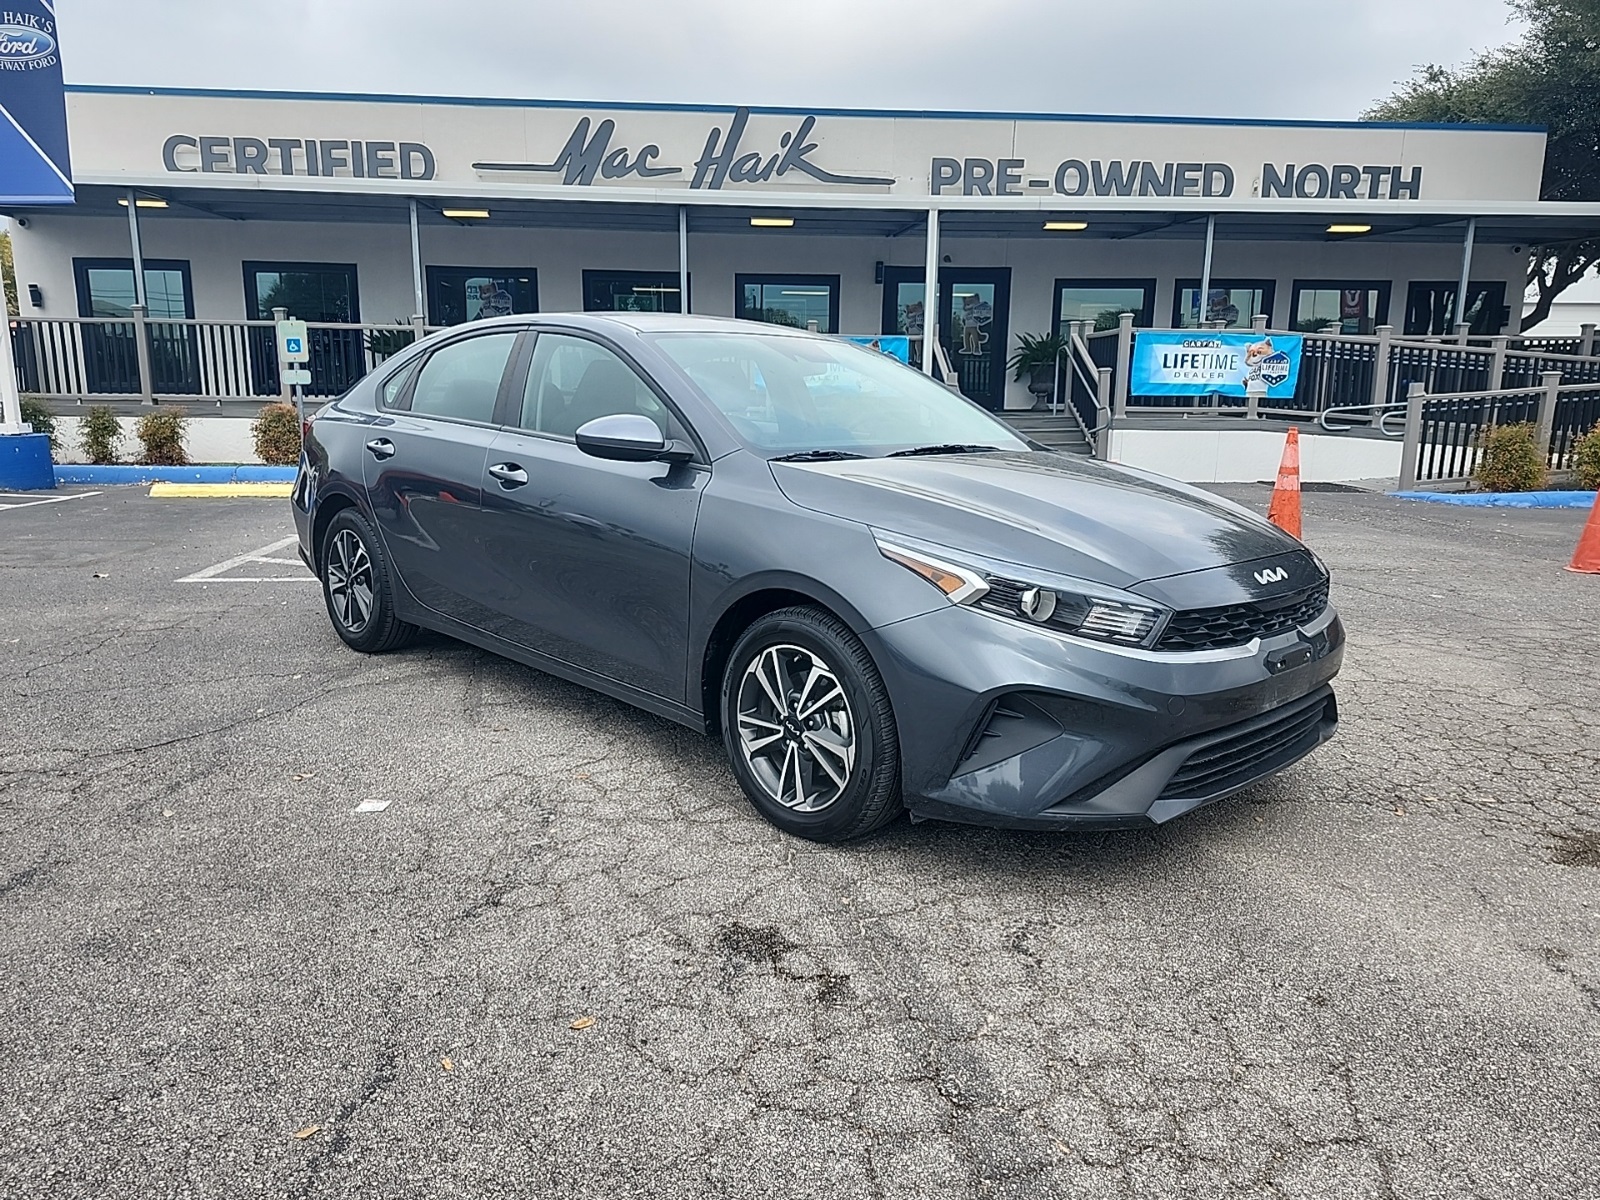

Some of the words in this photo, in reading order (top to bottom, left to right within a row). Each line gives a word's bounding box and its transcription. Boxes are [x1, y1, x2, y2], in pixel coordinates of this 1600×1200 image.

[3, 11, 54, 33] HAIK'S
[28, 55, 57, 70] FORD
[162, 134, 437, 181] CERTIFIED
[472, 116, 683, 186] Mac
[689, 106, 896, 190] Haik
[929, 157, 1235, 198] PRE-OWNED
[1260, 162, 1422, 200] NORTH
[1182, 340, 1222, 348] CARFAX
[1163, 353, 1239, 370] LIFETIME
[1174, 371, 1224, 379] DEALER
